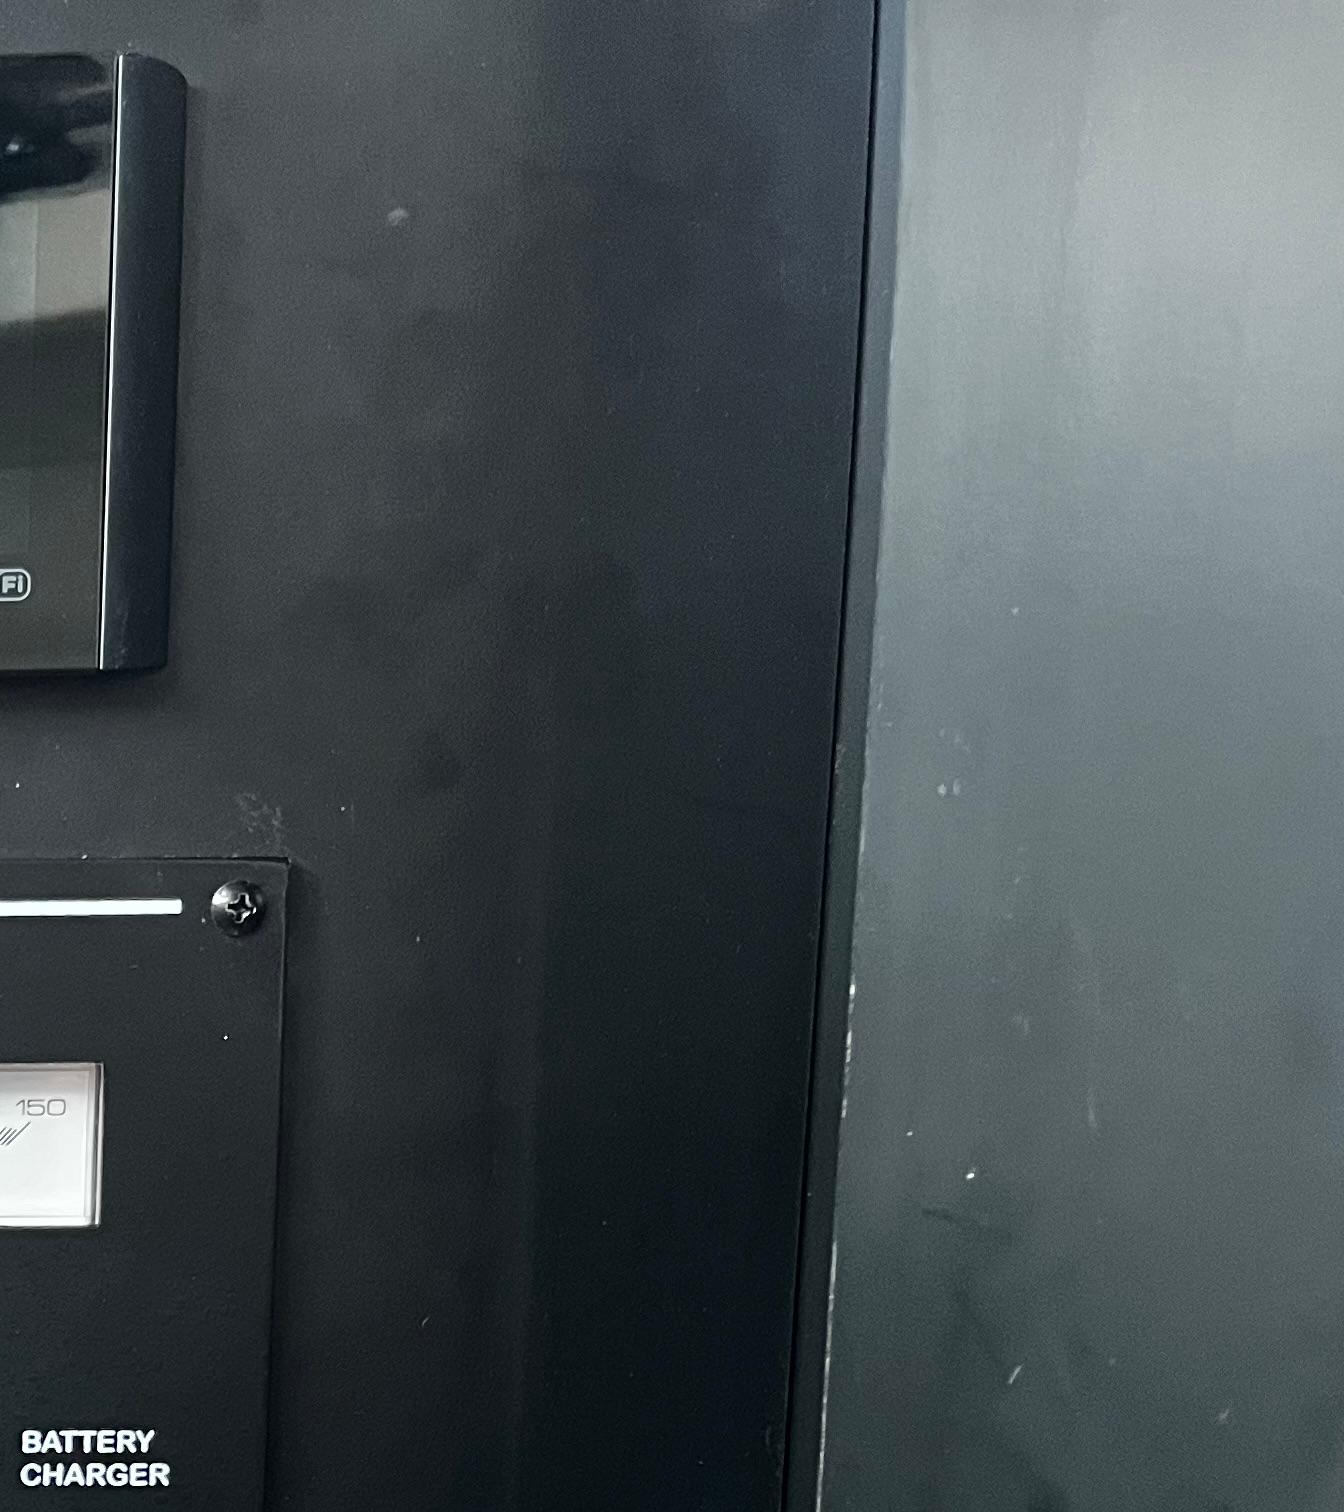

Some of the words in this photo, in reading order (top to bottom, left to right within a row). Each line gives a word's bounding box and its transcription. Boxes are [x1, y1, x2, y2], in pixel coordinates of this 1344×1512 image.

[15, 1098, 67, 1117] 150
[21, 1429, 156, 1454] BATTERY
[19, 1462, 171, 1487] CHARGER
